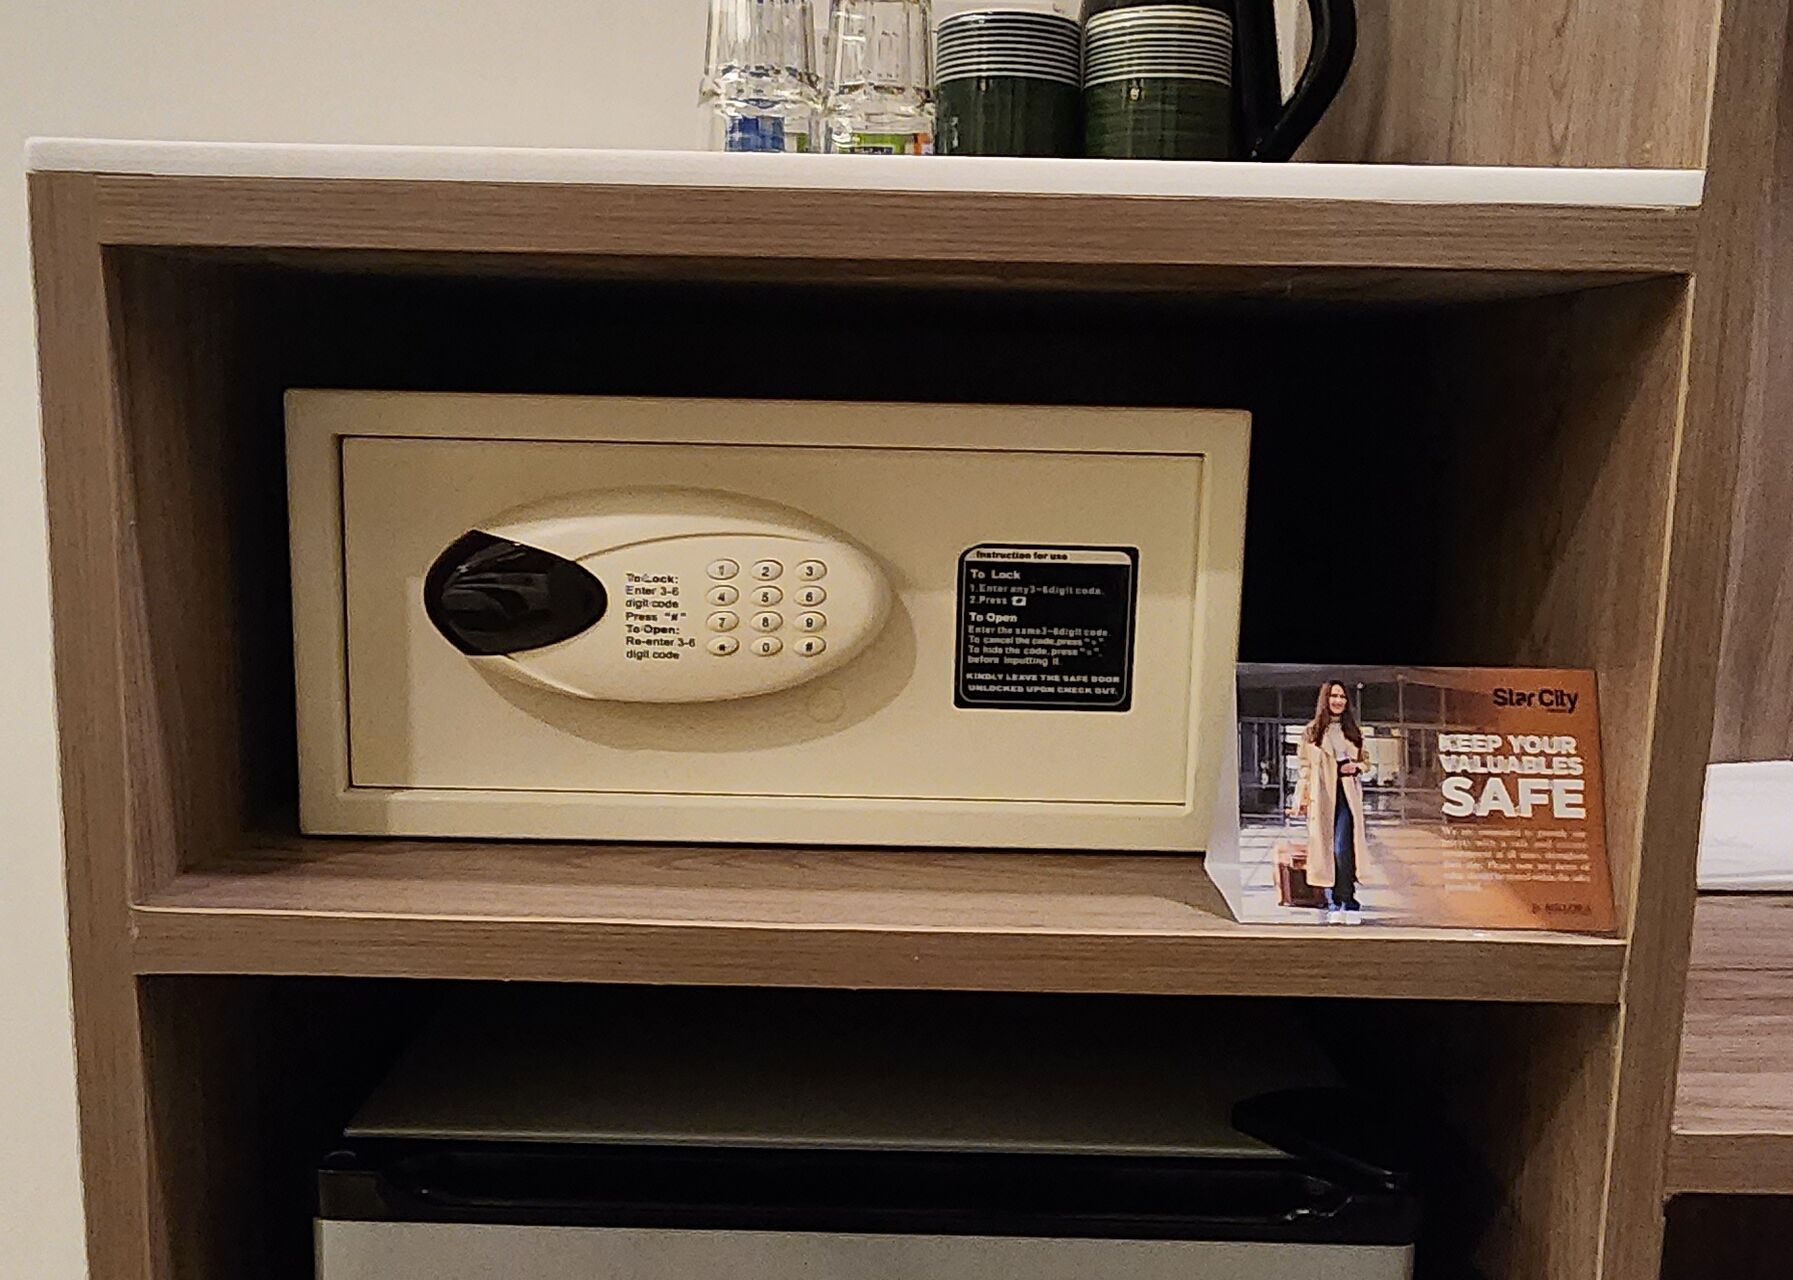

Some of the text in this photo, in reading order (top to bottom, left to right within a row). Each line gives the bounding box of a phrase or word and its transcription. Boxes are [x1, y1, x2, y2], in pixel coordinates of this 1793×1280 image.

[976, 550, 1032, 559] Instruction
[1033, 552, 1048, 560] for
[718, 565, 813, 577] 1 2 3
[970, 569, 1021, 580] To Lock
[626, 573, 679, 584] To Lock:
[625, 585, 679, 596] Enter 3-6
[717, 592, 813, 603] 4 5 6
[625, 599, 679, 609] digit code
[625, 612, 658, 621] Press
[969, 612, 1018, 624] To Open
[718, 617, 813, 628] 7 8 9
[625, 624, 680, 635] To Open:
[968, 625, 995, 634] Enter
[997, 626, 1012, 634] the
[625, 636, 696, 647] Re-enter 3-6
[968, 635, 980, 643] To
[983, 636, 1014, 644] cancel
[1015, 636, 1030, 644] the
[762, 642, 770, 653] 0
[805, 642, 813, 652] #
[968, 645, 980, 653] To
[983, 646, 1003, 654] hide
[1005, 646, 1020, 654] the
[626, 650, 680, 660] digit code
[967, 656, 1000, 664] before
[1004, 656, 1048, 667] inputting
[1006, 673, 1038, 681] LEAVE
[1040, 674, 1061, 682] THE
[1062, 674, 1088, 682] SAFE
[1091, 675, 1120, 683] DOOR
[968, 684, 1024, 692] UNLOCKED
[1026, 685, 1055, 693] UPON
[1057, 686, 1092, 694] CHECK
[1493, 688, 1579, 714] Star City
[1438, 733, 1576, 755] KEEP YOUR
[1438, 755, 1584, 775] VALUABLES
[1441, 776, 1586, 819] SAFE
